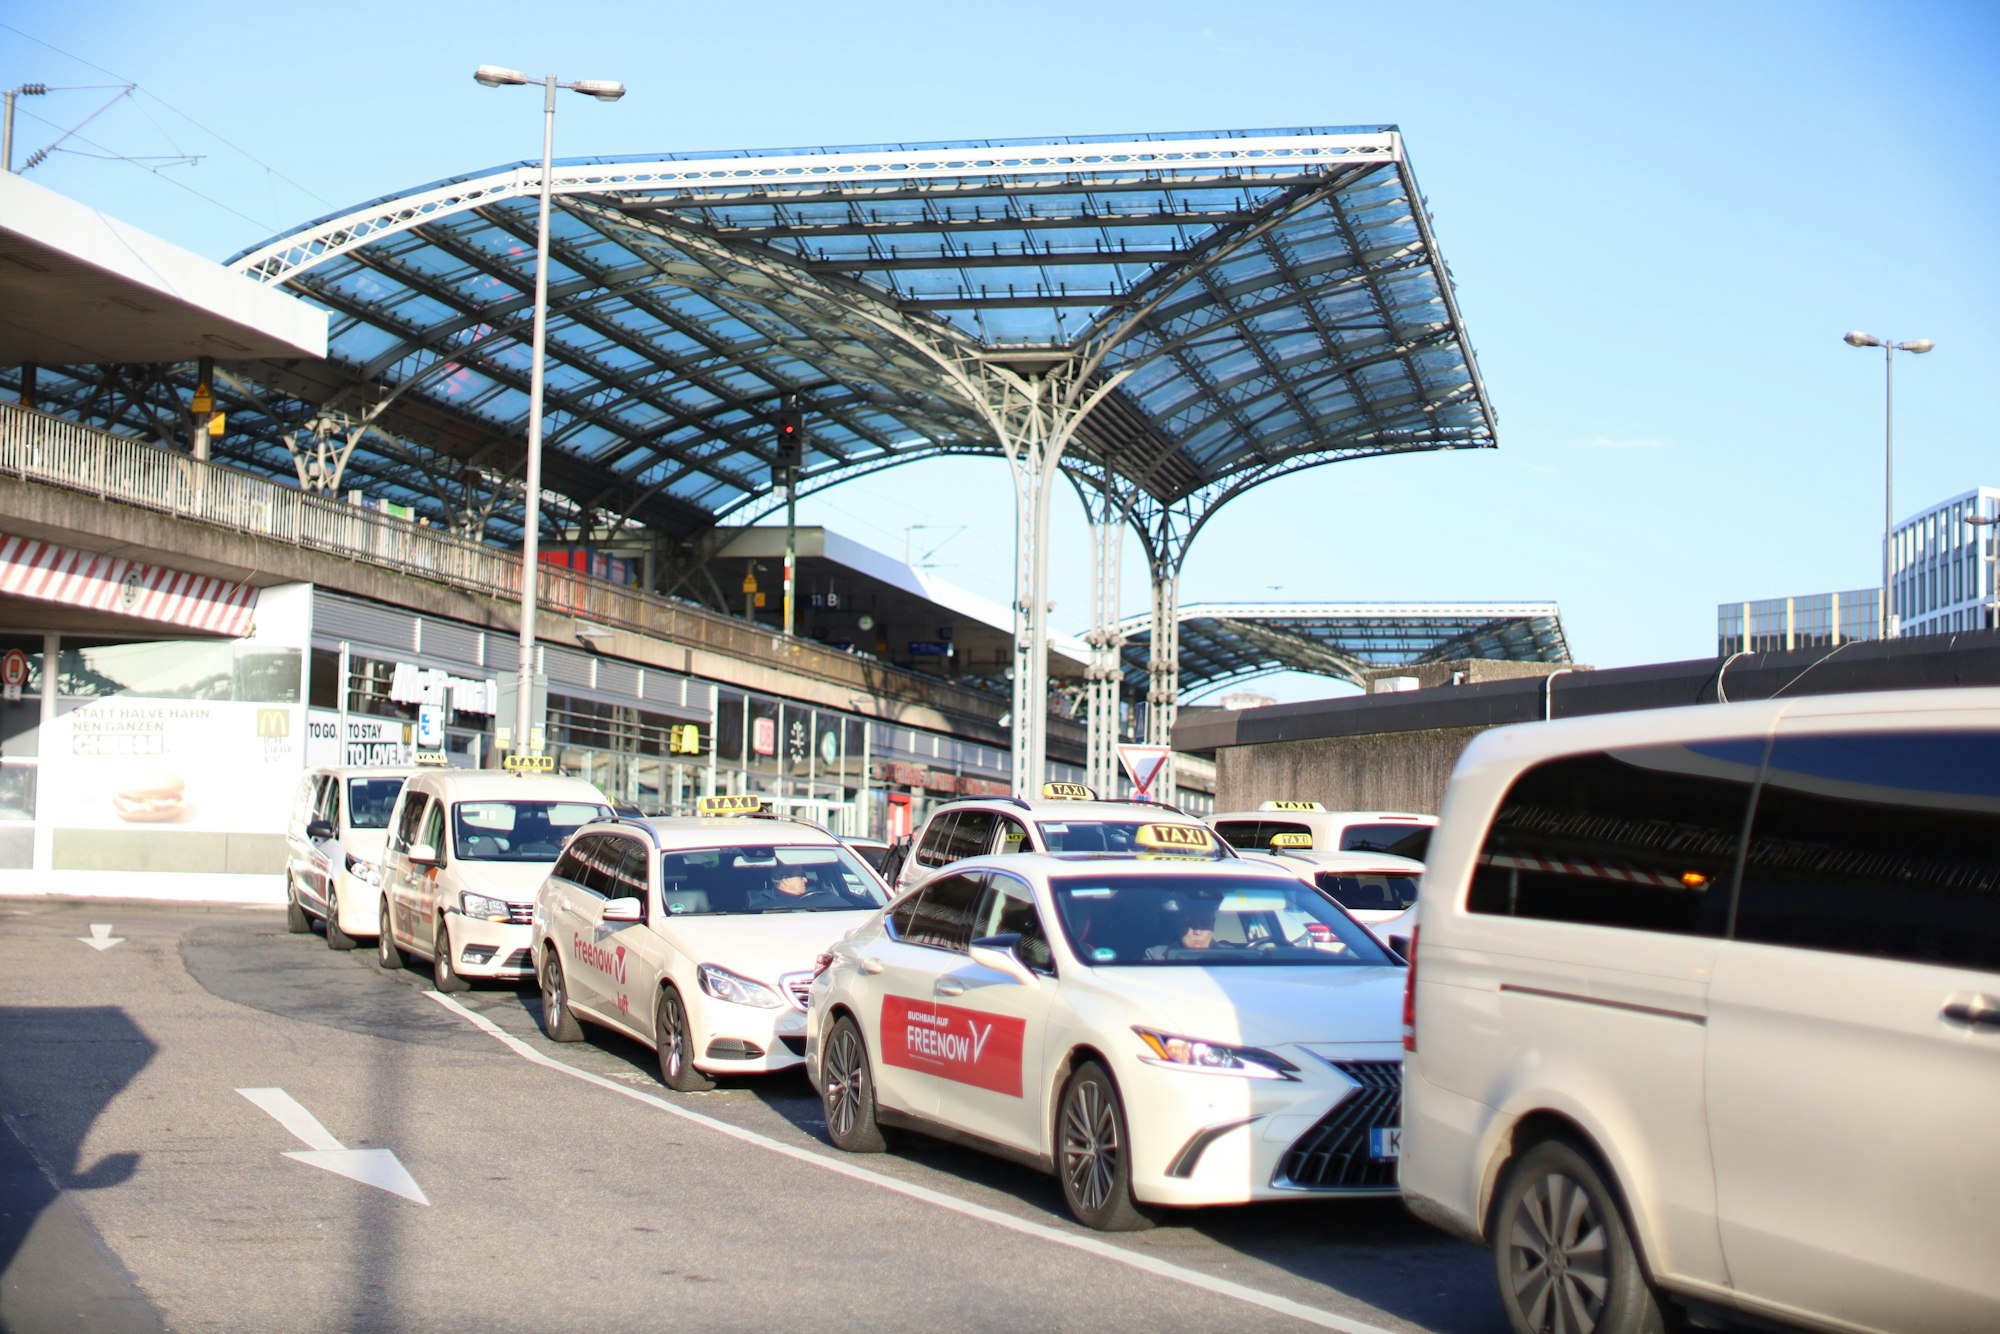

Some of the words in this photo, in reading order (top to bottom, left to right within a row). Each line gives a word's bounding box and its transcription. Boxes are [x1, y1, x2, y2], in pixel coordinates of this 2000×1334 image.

[72, 707, 115, 719] STATT
[120, 708, 165, 719] HALVE
[72, 721, 102, 732] NEN
[105, 721, 164, 732] GANZEN
[309, 723, 321, 738] TO
[348, 724, 360, 738] TO
[361, 724, 382, 739] STAY
[347, 743, 365, 766] TO
[515, 757, 547, 767] TAXI
[1055, 784, 1084, 796] TAXI
[711, 797, 752, 809] TAXI
[1156, 826, 1205, 845] TAXI
[1283, 836, 1309, 844] TAXI
[907, 1011, 936, 1024] BUCHBAR
[936, 1017, 949, 1027] AUF
[907, 1025, 970, 1063] FREENOW
[1390, 1131, 1401, 1153] K
